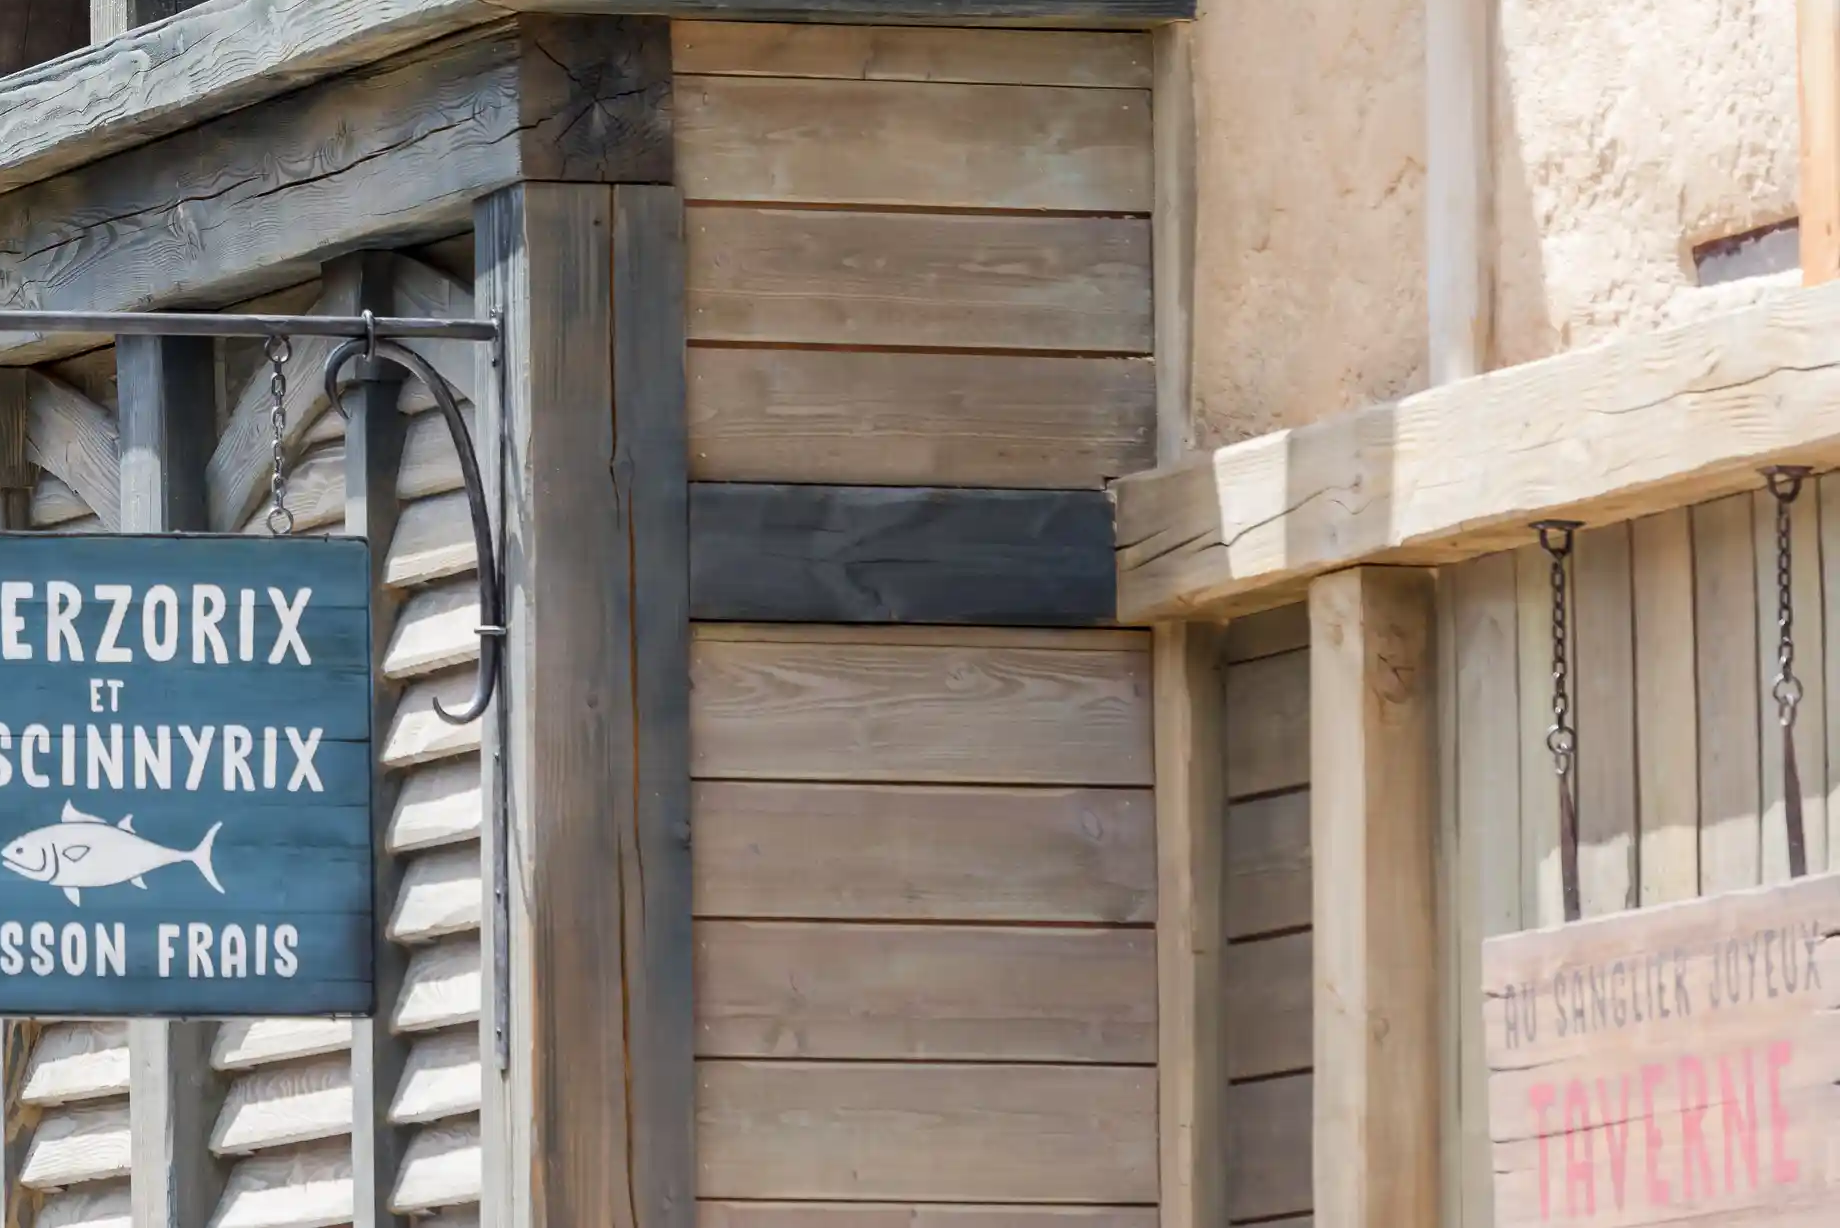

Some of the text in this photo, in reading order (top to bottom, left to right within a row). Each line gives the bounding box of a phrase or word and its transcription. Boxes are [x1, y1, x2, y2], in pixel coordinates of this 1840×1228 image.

[90, 678, 124, 713] ET
[158, 922, 298, 978] FRAIS
[1503, 919, 1823, 1050] AU SANGLIER JOYEUX
[1528, 1039, 1801, 1220] TAVERNE
